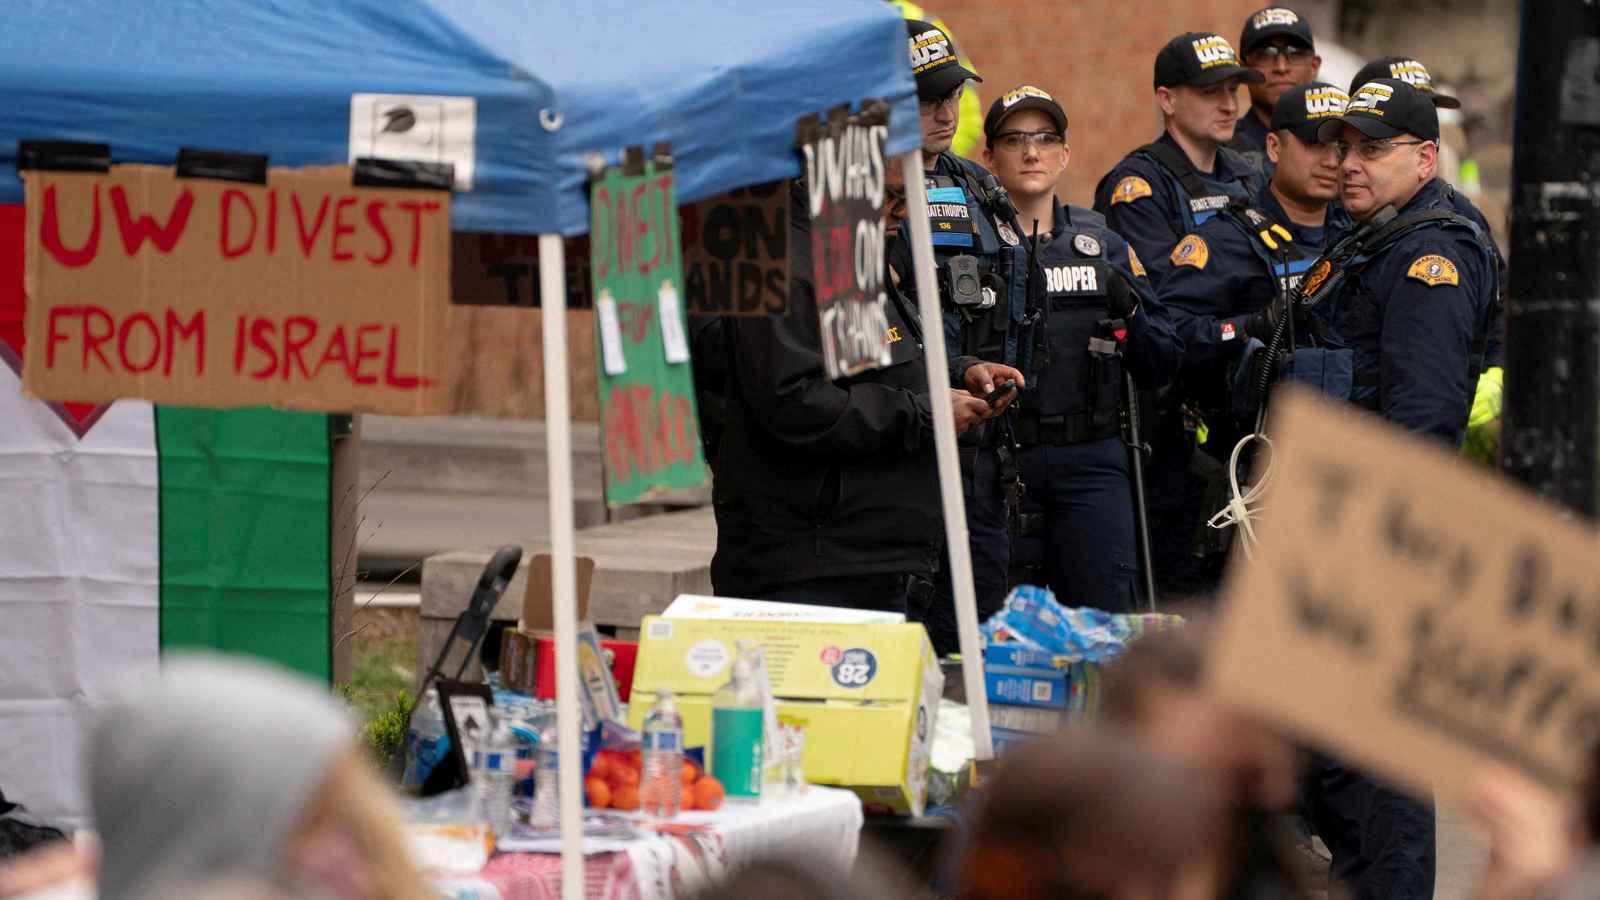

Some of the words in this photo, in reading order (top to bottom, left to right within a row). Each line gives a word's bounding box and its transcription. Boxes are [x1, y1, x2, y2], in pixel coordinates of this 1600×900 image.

[40, 185, 195, 268] UW
[219, 188, 440, 267] DIVEST
[704, 205, 785, 257] ON
[943, 204, 969, 218] TROOPER
[685, 260, 786, 312] ANDS
[1044, 266, 1097, 292] ROOPER
[45, 305, 206, 378] FROM
[234, 315, 438, 390] ISRAEL
[838, 664, 869, 685] 28
